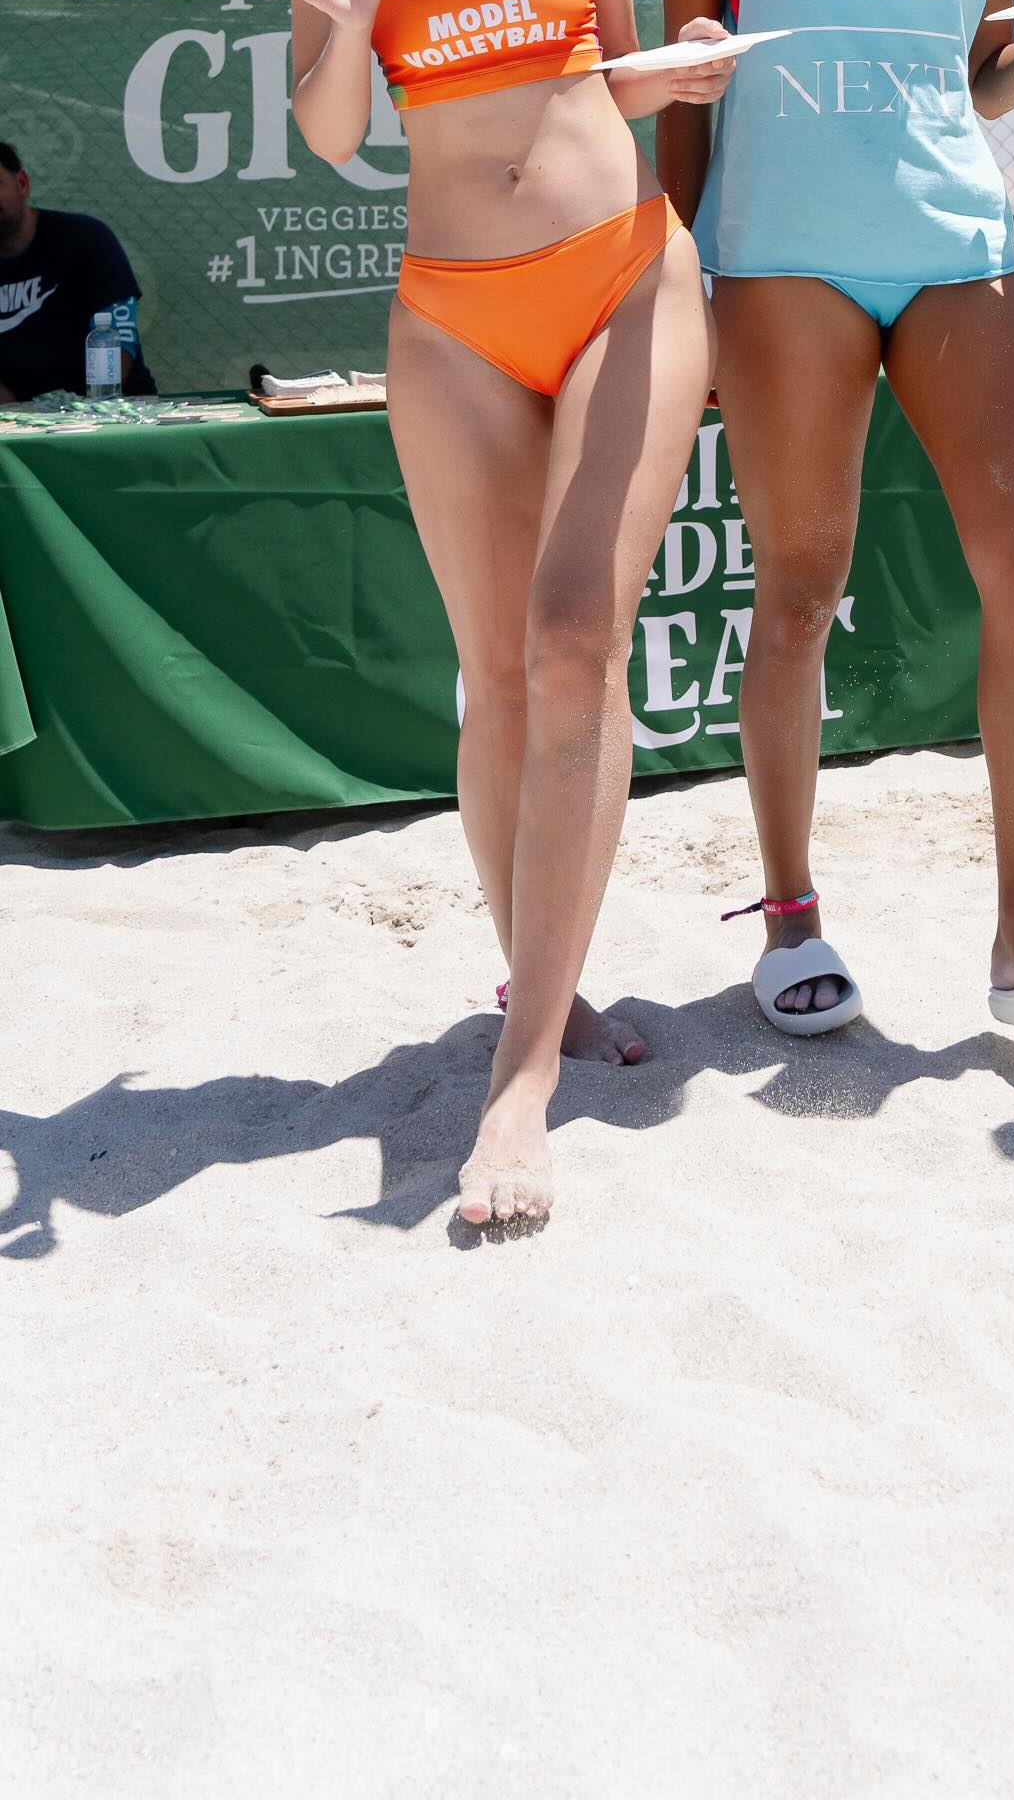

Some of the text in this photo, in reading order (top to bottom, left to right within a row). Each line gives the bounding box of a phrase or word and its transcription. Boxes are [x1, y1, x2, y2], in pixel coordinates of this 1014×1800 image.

[402, 20, 568, 69] VOLLEYBALL
[772, 60, 964, 118] NEXT
[257, 206, 408, 232] VEGGIES
[207, 236, 266, 287] #1
